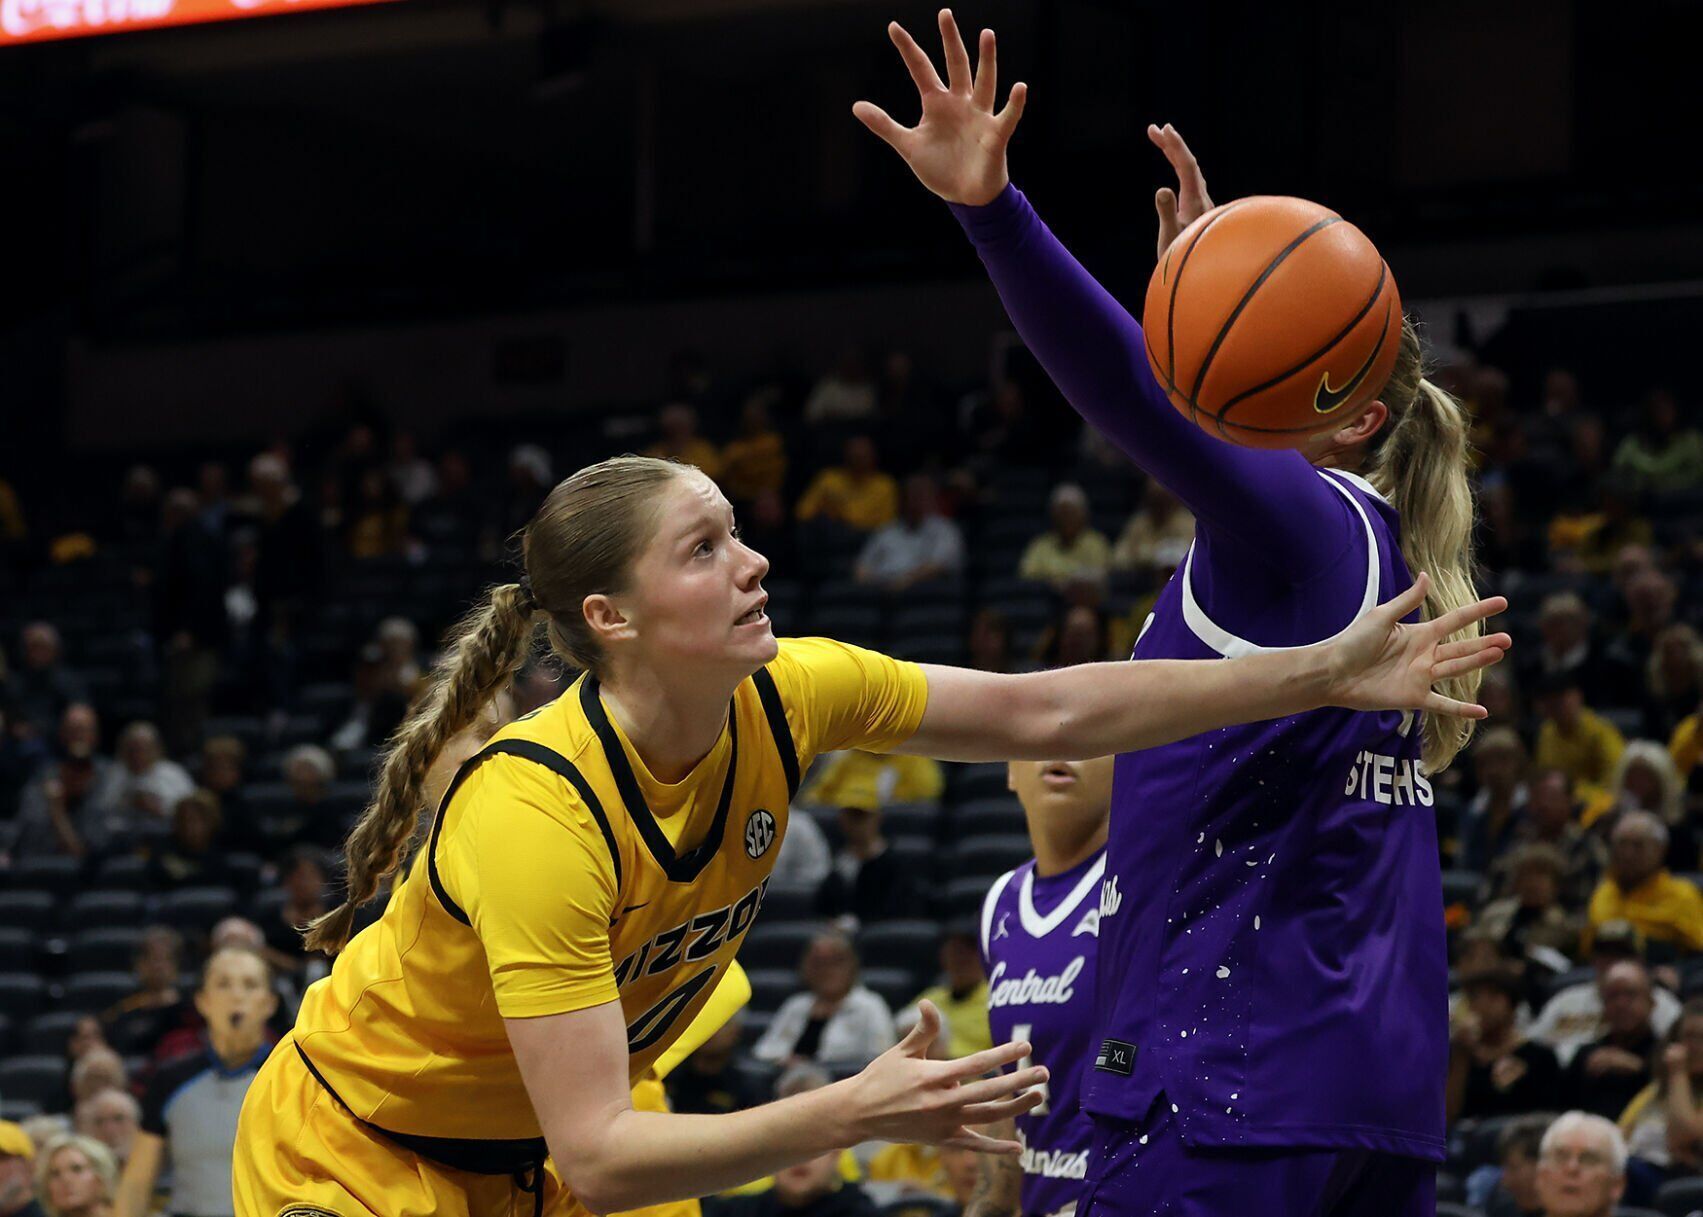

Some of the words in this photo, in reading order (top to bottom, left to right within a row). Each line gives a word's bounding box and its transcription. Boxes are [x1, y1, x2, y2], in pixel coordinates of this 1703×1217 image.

[1344, 750, 1435, 807] STEHS
[745, 810, 775, 858] SEC
[988, 955, 1086, 1010] Central
[1111, 1049, 1127, 1065] XL
